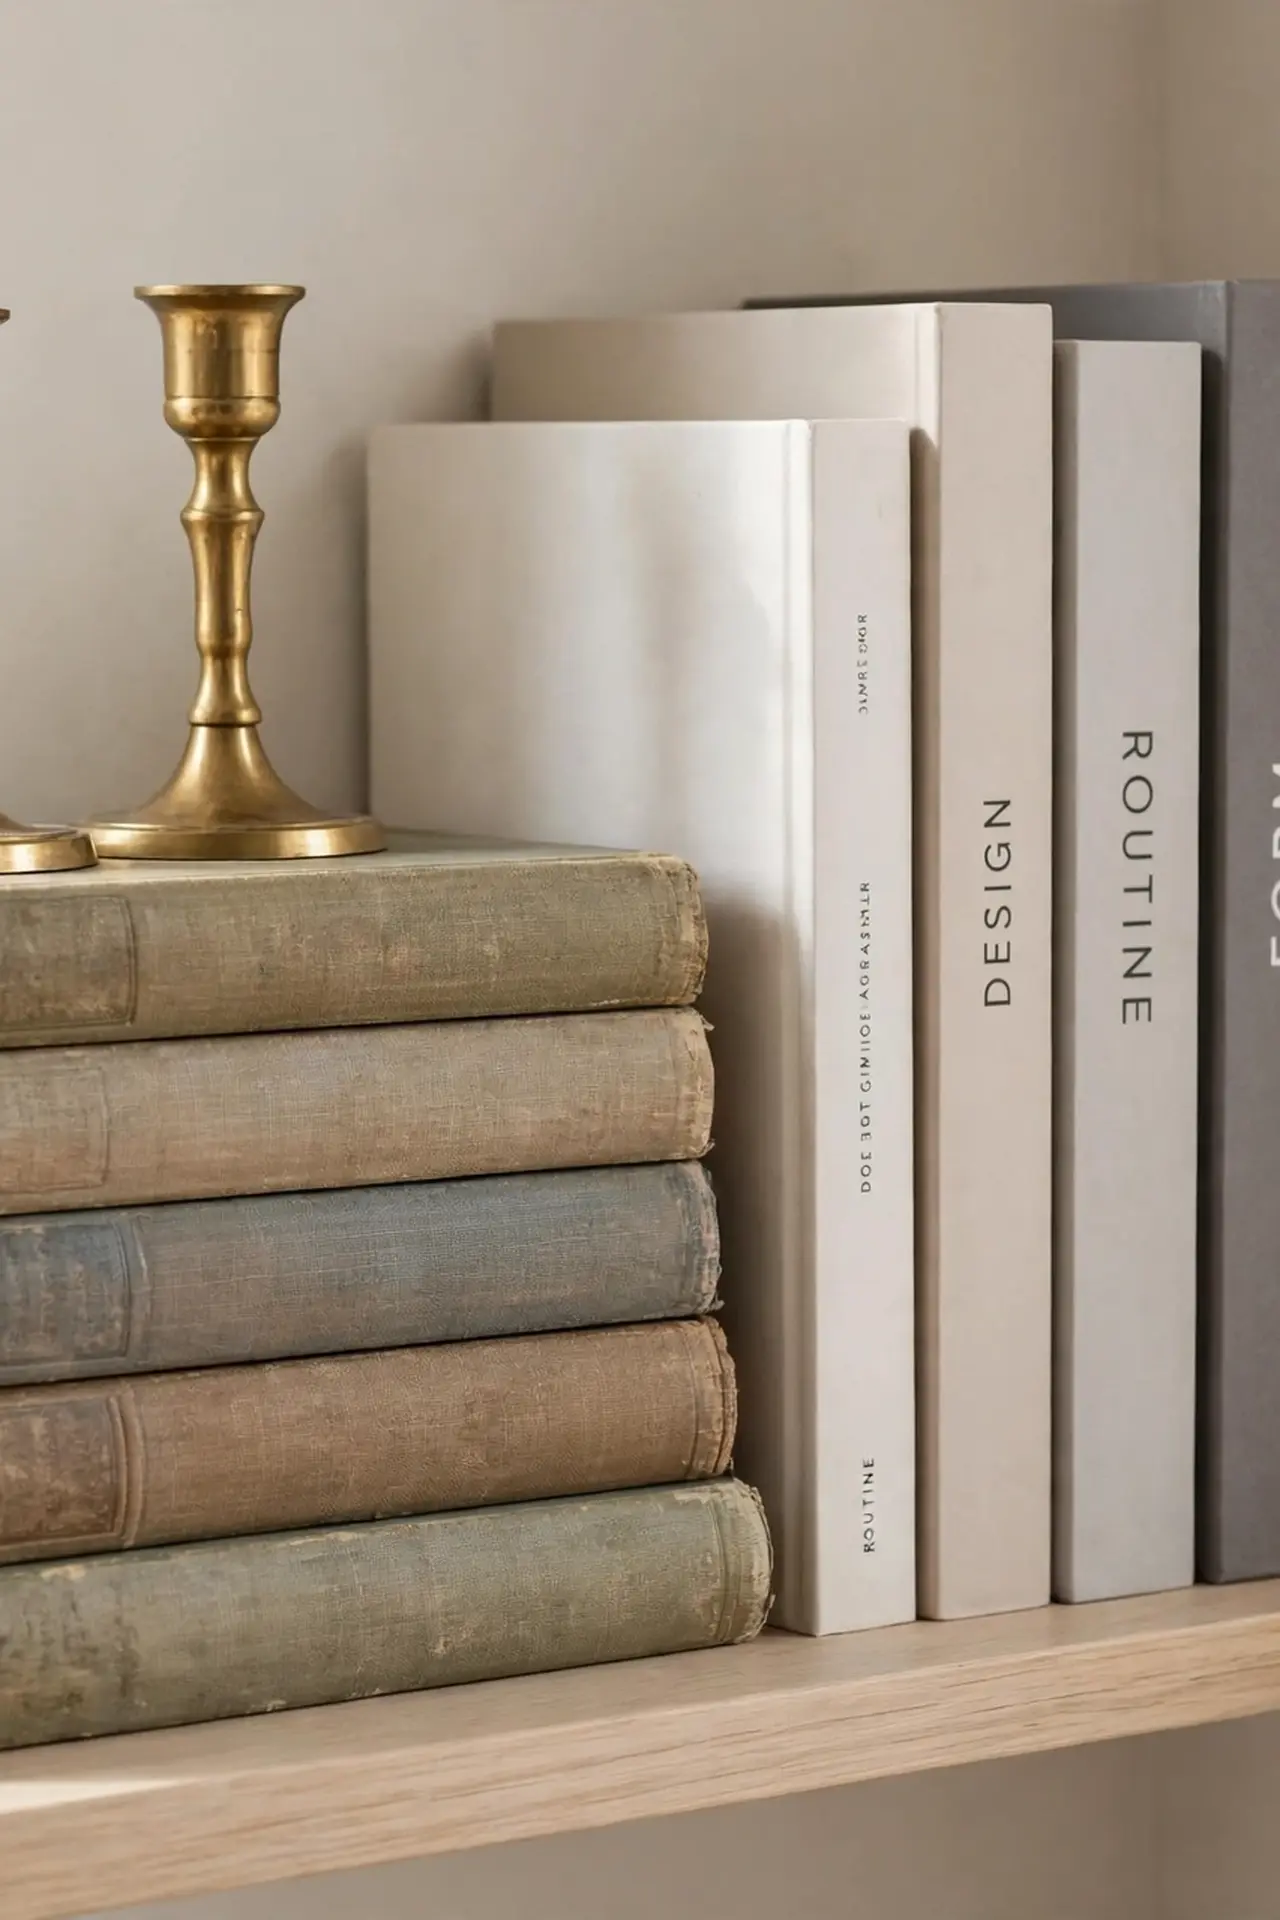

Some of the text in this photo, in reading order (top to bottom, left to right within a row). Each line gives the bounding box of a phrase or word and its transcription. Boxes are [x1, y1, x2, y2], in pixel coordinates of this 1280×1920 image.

[982, 799, 1012, 1007] DESIGN
[1121, 731, 1154, 1025] ROUTINE
[862, 1456, 875, 1554] ROUTINE
